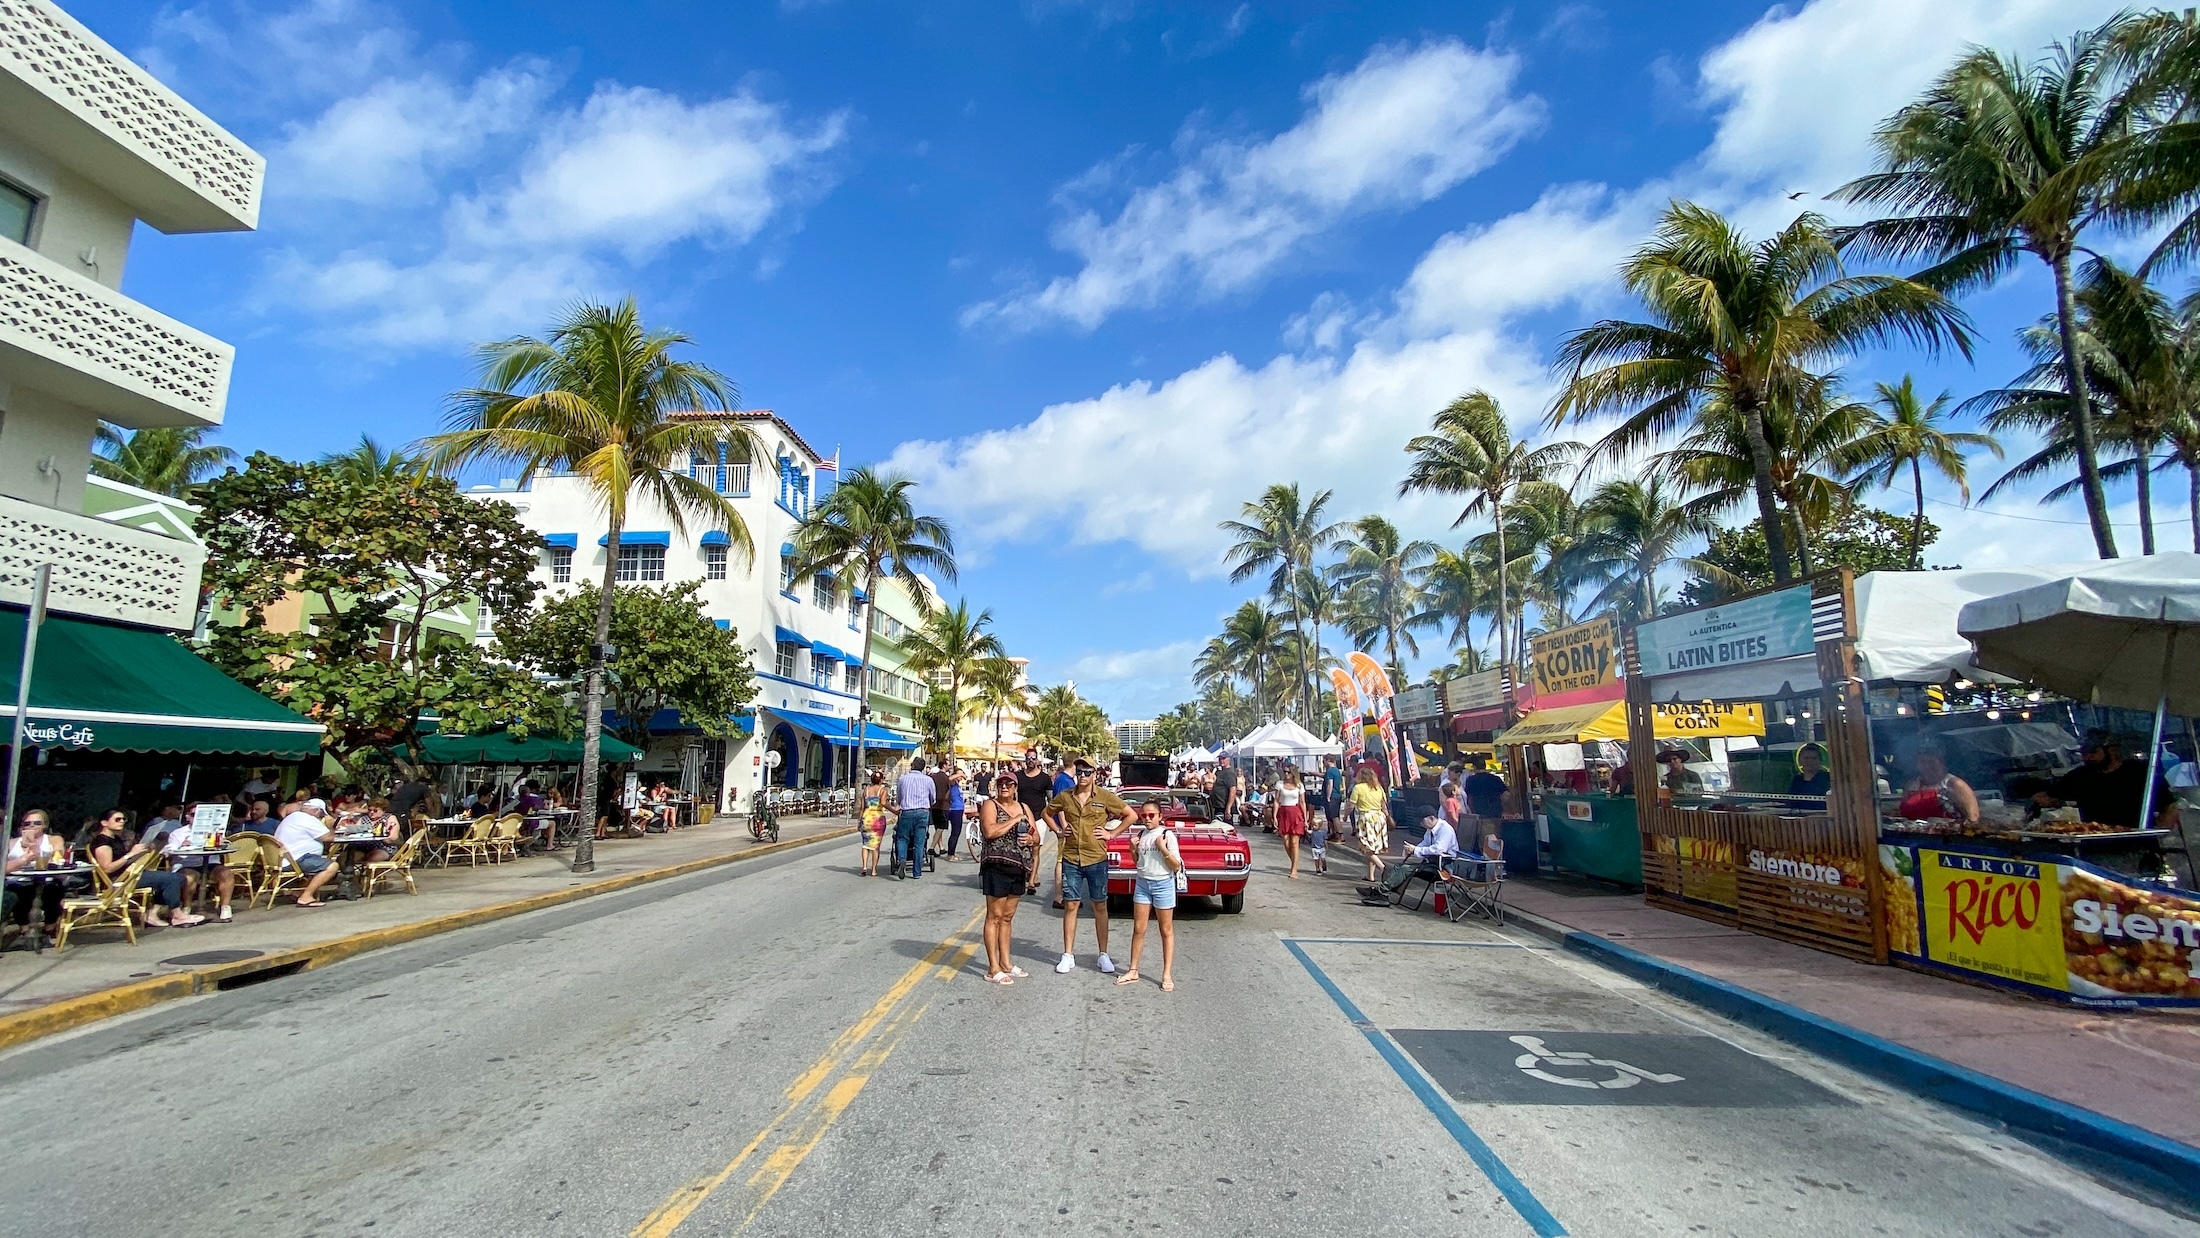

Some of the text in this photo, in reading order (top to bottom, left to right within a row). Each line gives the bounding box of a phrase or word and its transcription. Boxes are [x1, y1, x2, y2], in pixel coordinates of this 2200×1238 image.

[1548, 638, 1565, 651] FRESH
[1566, 628, 1591, 647] ROASTED
[1593, 621, 1609, 639] CORN
[1689, 621, 1737, 637] LA AUTENTICA
[1547, 643, 1596, 678] CORN
[1668, 636, 1768, 670] LATIN BITES
[1552, 674, 1596, 692] ON THE COB
[1343, 724, 1361, 740] DECO
[1674, 716, 1720, 729] CORN
[1344, 734, 1361, 751] KIDS
[1749, 849, 1841, 885] Siempre
[1942, 855, 2036, 878] ARROZ
[1943, 876, 2041, 945] Rico
[1959, 956, 1972, 966] que
[1973, 957, 1980, 967] le
[1982, 961, 2003, 971] gusta
[2004, 965, 2010, 974] a
[2012, 966, 2022, 977] mi
